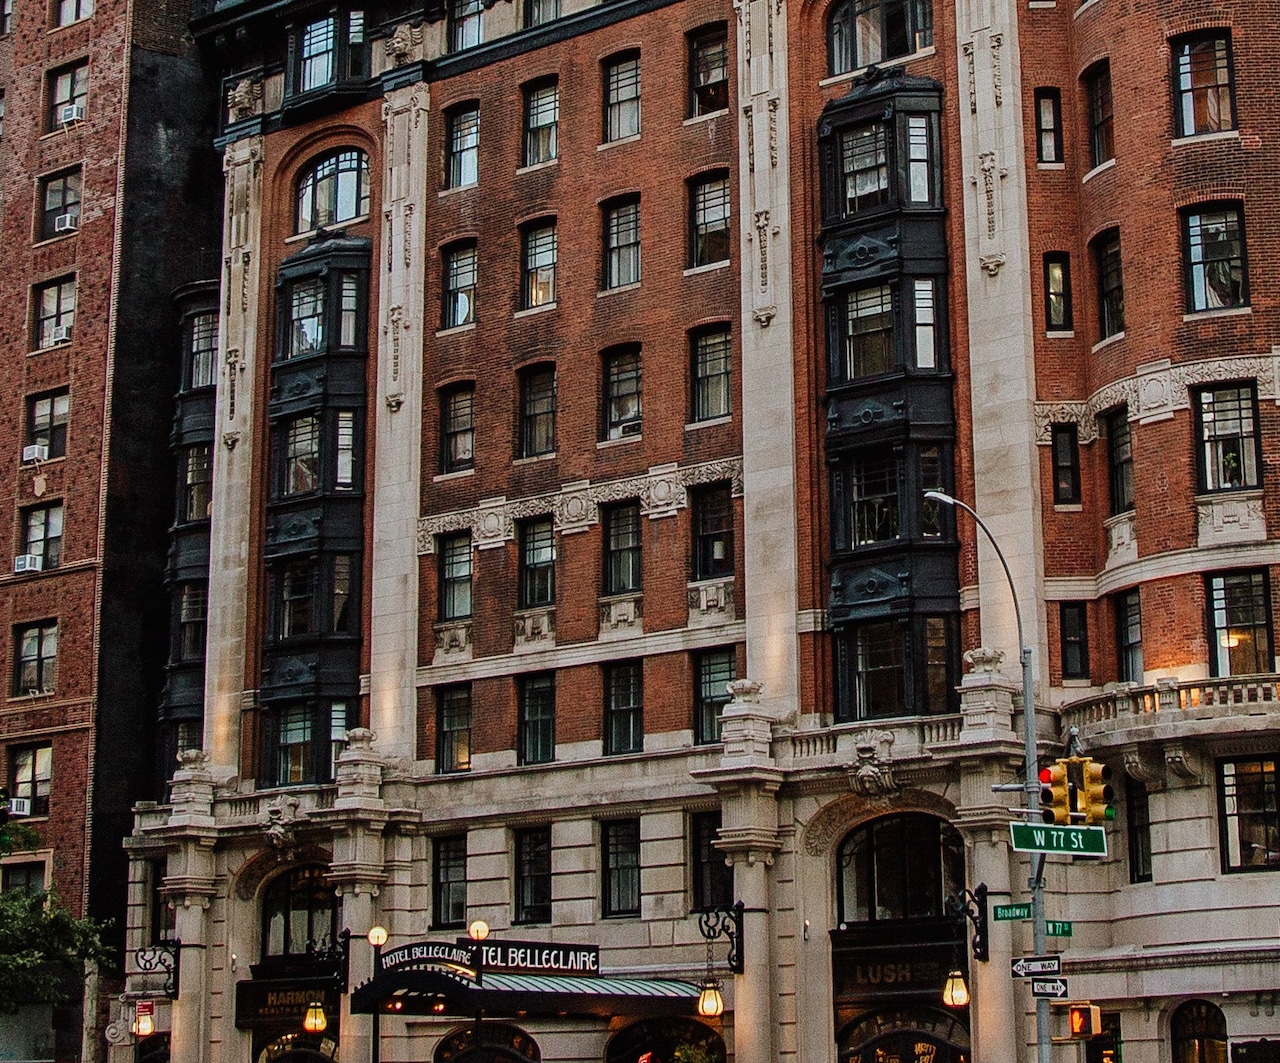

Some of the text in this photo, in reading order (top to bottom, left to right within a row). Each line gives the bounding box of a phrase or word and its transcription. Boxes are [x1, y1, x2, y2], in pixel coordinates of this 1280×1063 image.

[1033, 829, 1084, 849] W 77 St
[997, 906, 1028, 919] Broadway
[1047, 922, 1053, 934] W
[1055, 922, 1062, 934] 77
[381, 945, 471, 970] HOTEL BELLECLAIRE
[482, 946, 598, 971] TEL BELLECLAIRE
[856, 963, 911, 984] LUSH
[1016, 962, 1056, 972] ONE WAY
[1036, 983, 1062, 992] ONE WAY
[267, 989, 326, 1006] HARMON
